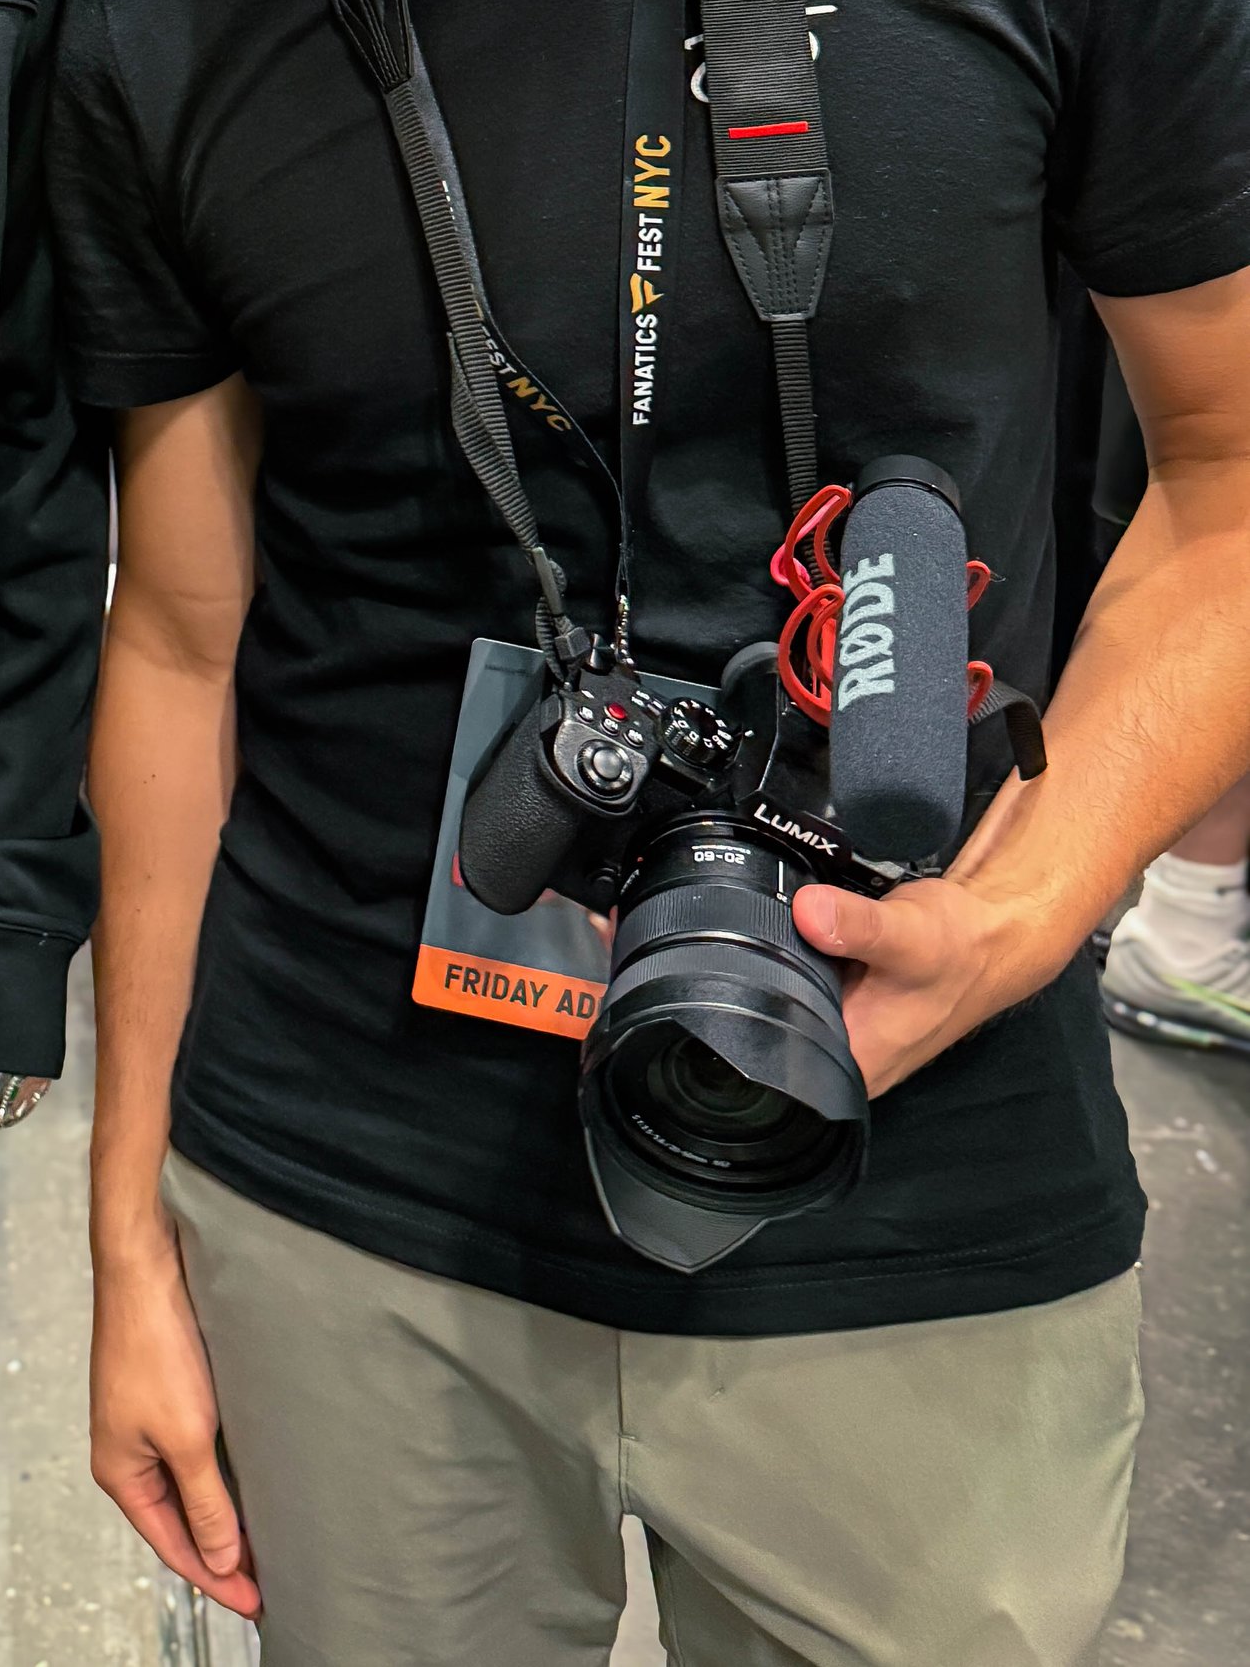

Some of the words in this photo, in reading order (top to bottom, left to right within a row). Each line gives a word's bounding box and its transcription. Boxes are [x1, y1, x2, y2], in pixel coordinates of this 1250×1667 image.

[633, 134, 672, 209] NYC
[636, 212, 664, 272] FEST
[632, 312, 659, 426] FANATICS
[506, 376, 573, 432] NYC
[693, 850, 746, 865] 20-60
[753, 802, 841, 858] LUMIX
[444, 963, 549, 1008] FRIDAY
[555, 988, 605, 1020] AD
